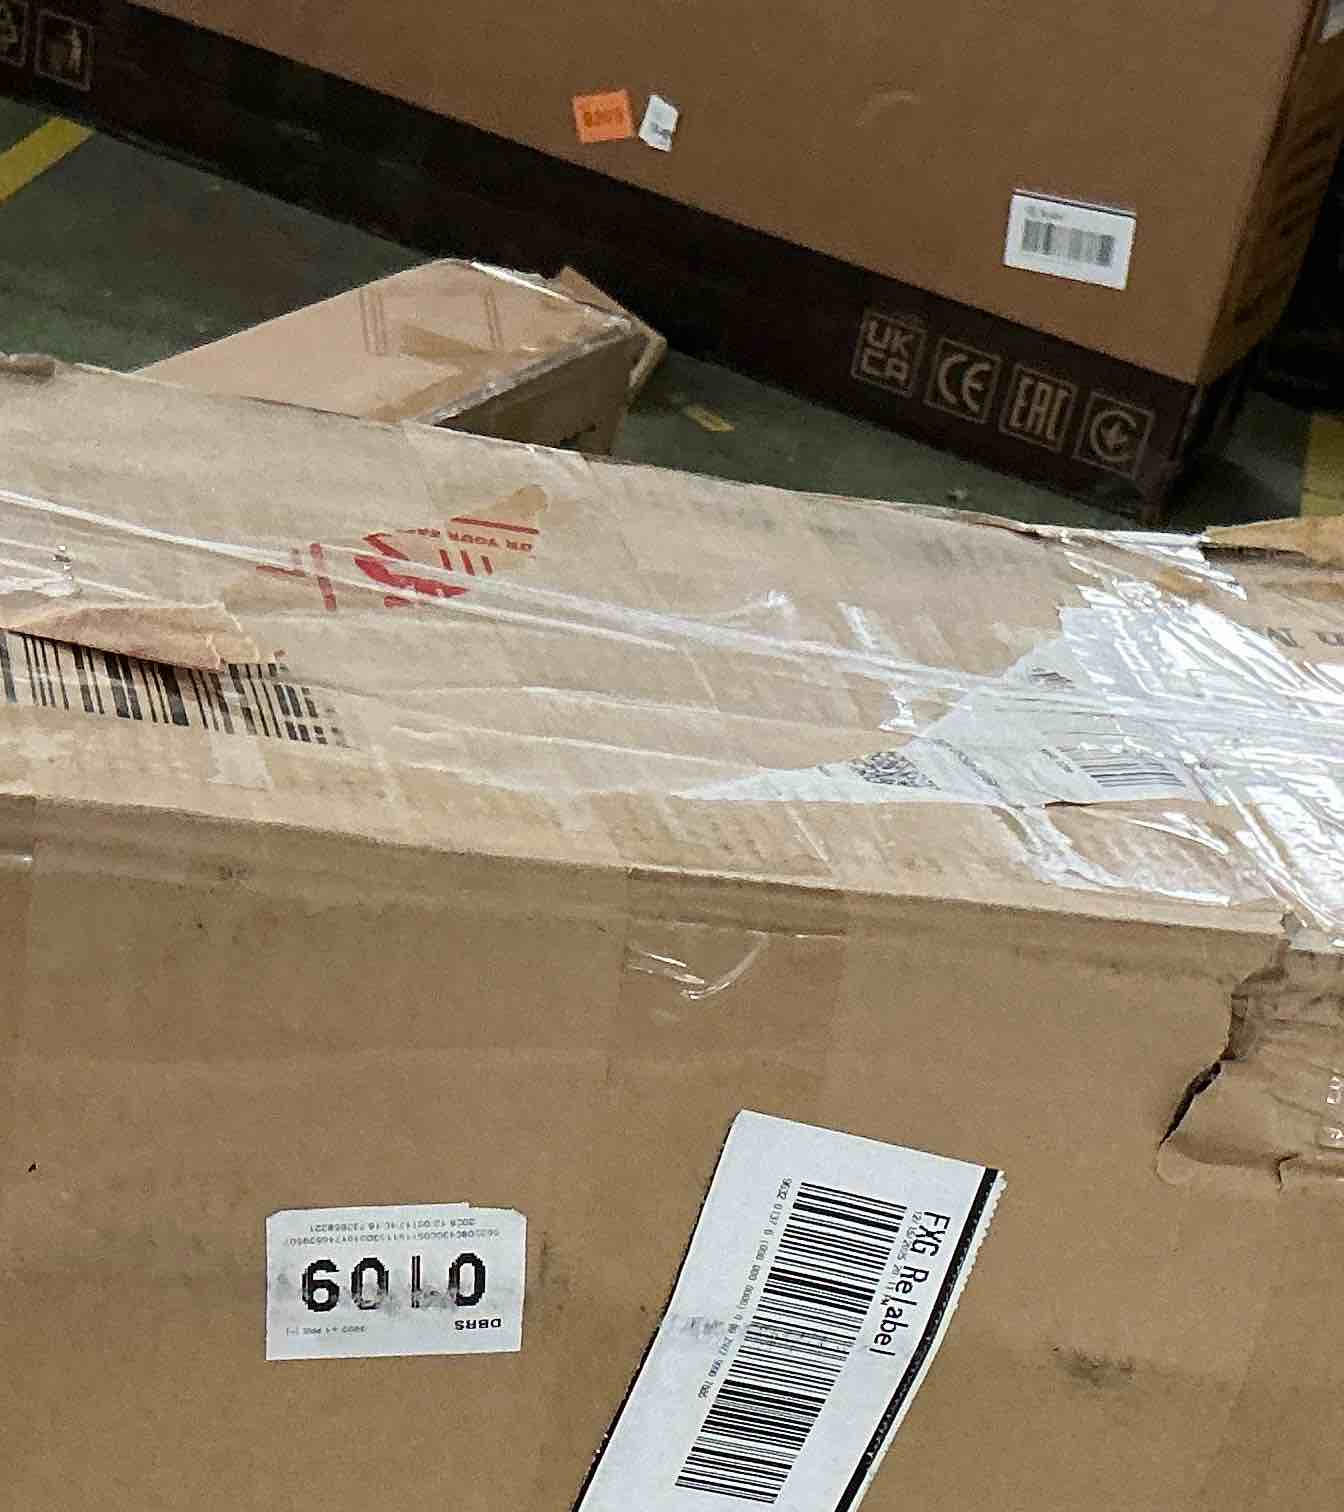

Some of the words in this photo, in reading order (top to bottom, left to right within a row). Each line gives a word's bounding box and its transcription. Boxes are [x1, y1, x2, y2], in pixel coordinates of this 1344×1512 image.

[937, 352, 993, 413] CE
[1009, 374, 1072, 441] EAC
[910, 1211, 951, 1257] FXG
[301, 1252, 486, 1313] 0109
[869, 1265, 930, 1357] Relabel
